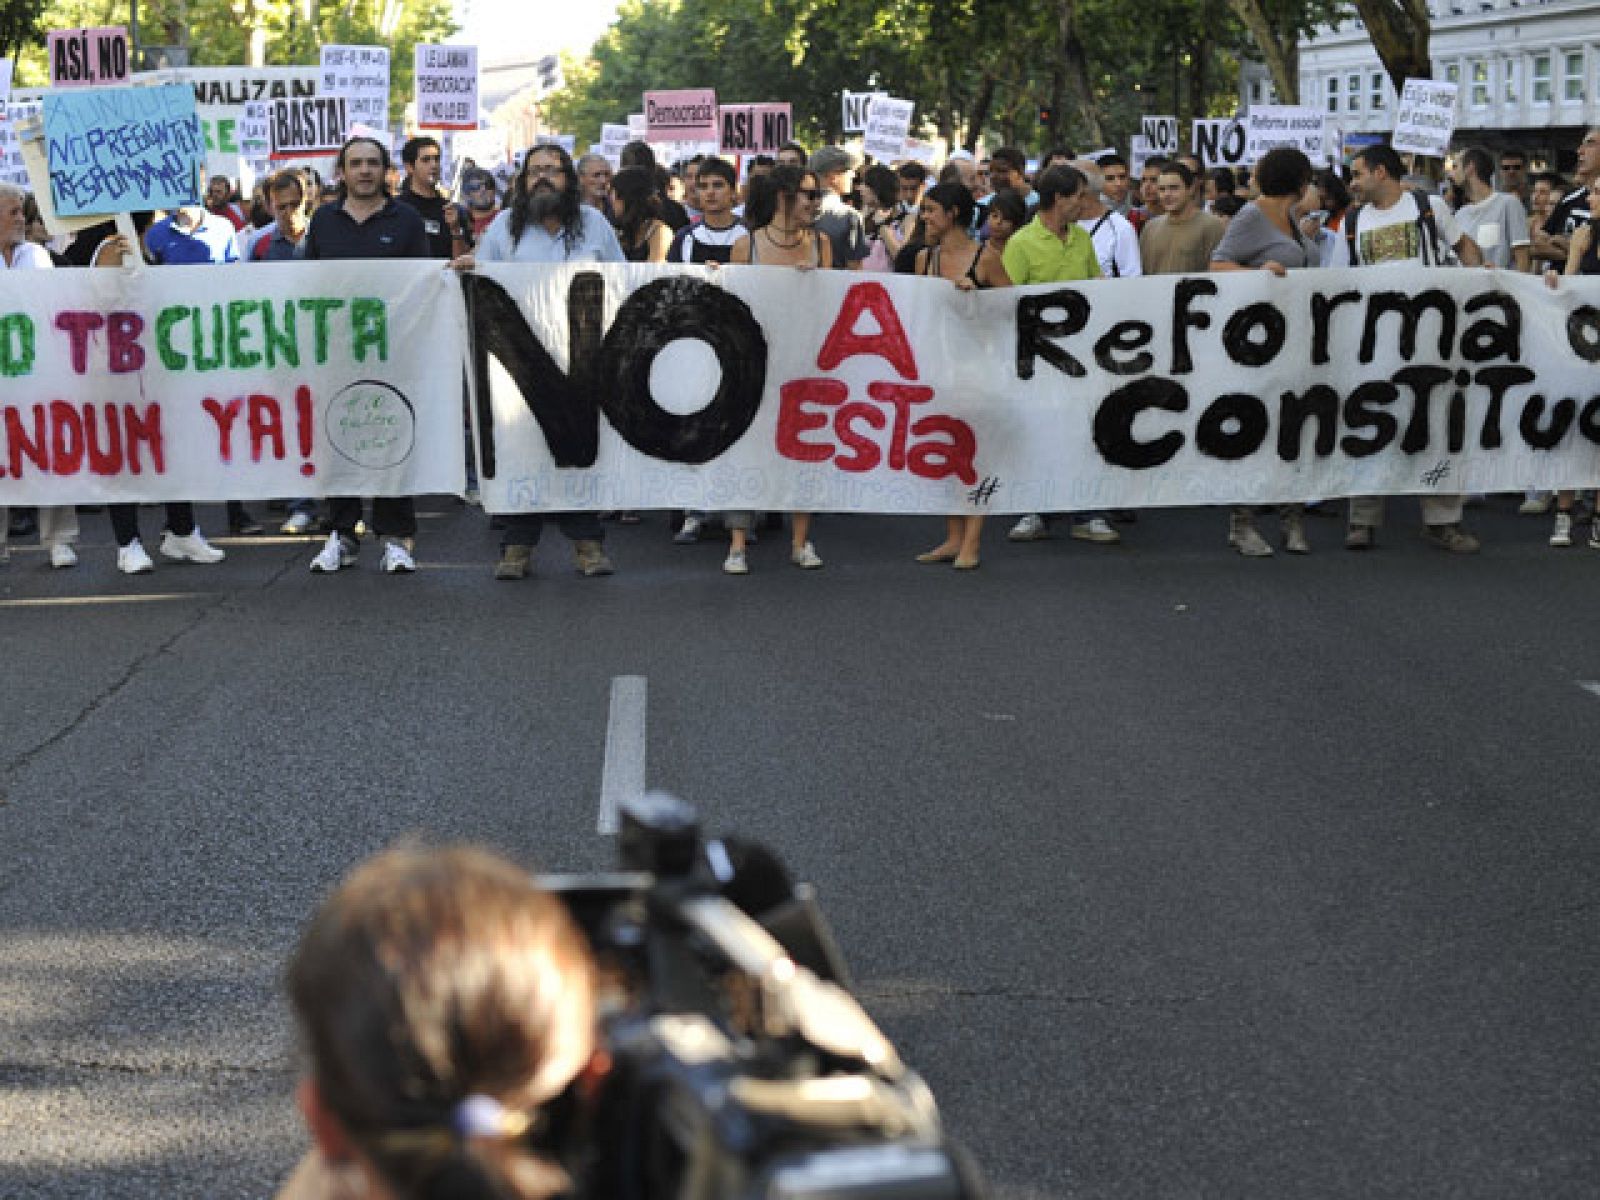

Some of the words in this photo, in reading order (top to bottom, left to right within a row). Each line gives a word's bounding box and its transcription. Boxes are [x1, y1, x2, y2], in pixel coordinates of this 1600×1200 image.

[97, 34, 126, 79] NO
[425, 50, 435, 68] LE
[437, 50, 468, 68] LLAMAN
[648, 97, 711, 125] Democracia
[762, 111, 789, 150] NO
[1251, 114, 1288, 130] Reforma
[1144, 117, 1177, 150] NO!
[1196, 122, 1246, 163] NO
[55, 310, 145, 375] TB
[155, 296, 389, 372] CUENTA
[462, 270, 768, 480] NO
[816, 281, 919, 381] A
[0, 399, 166, 480] NDUM
[201, 383, 317, 477] YA!
